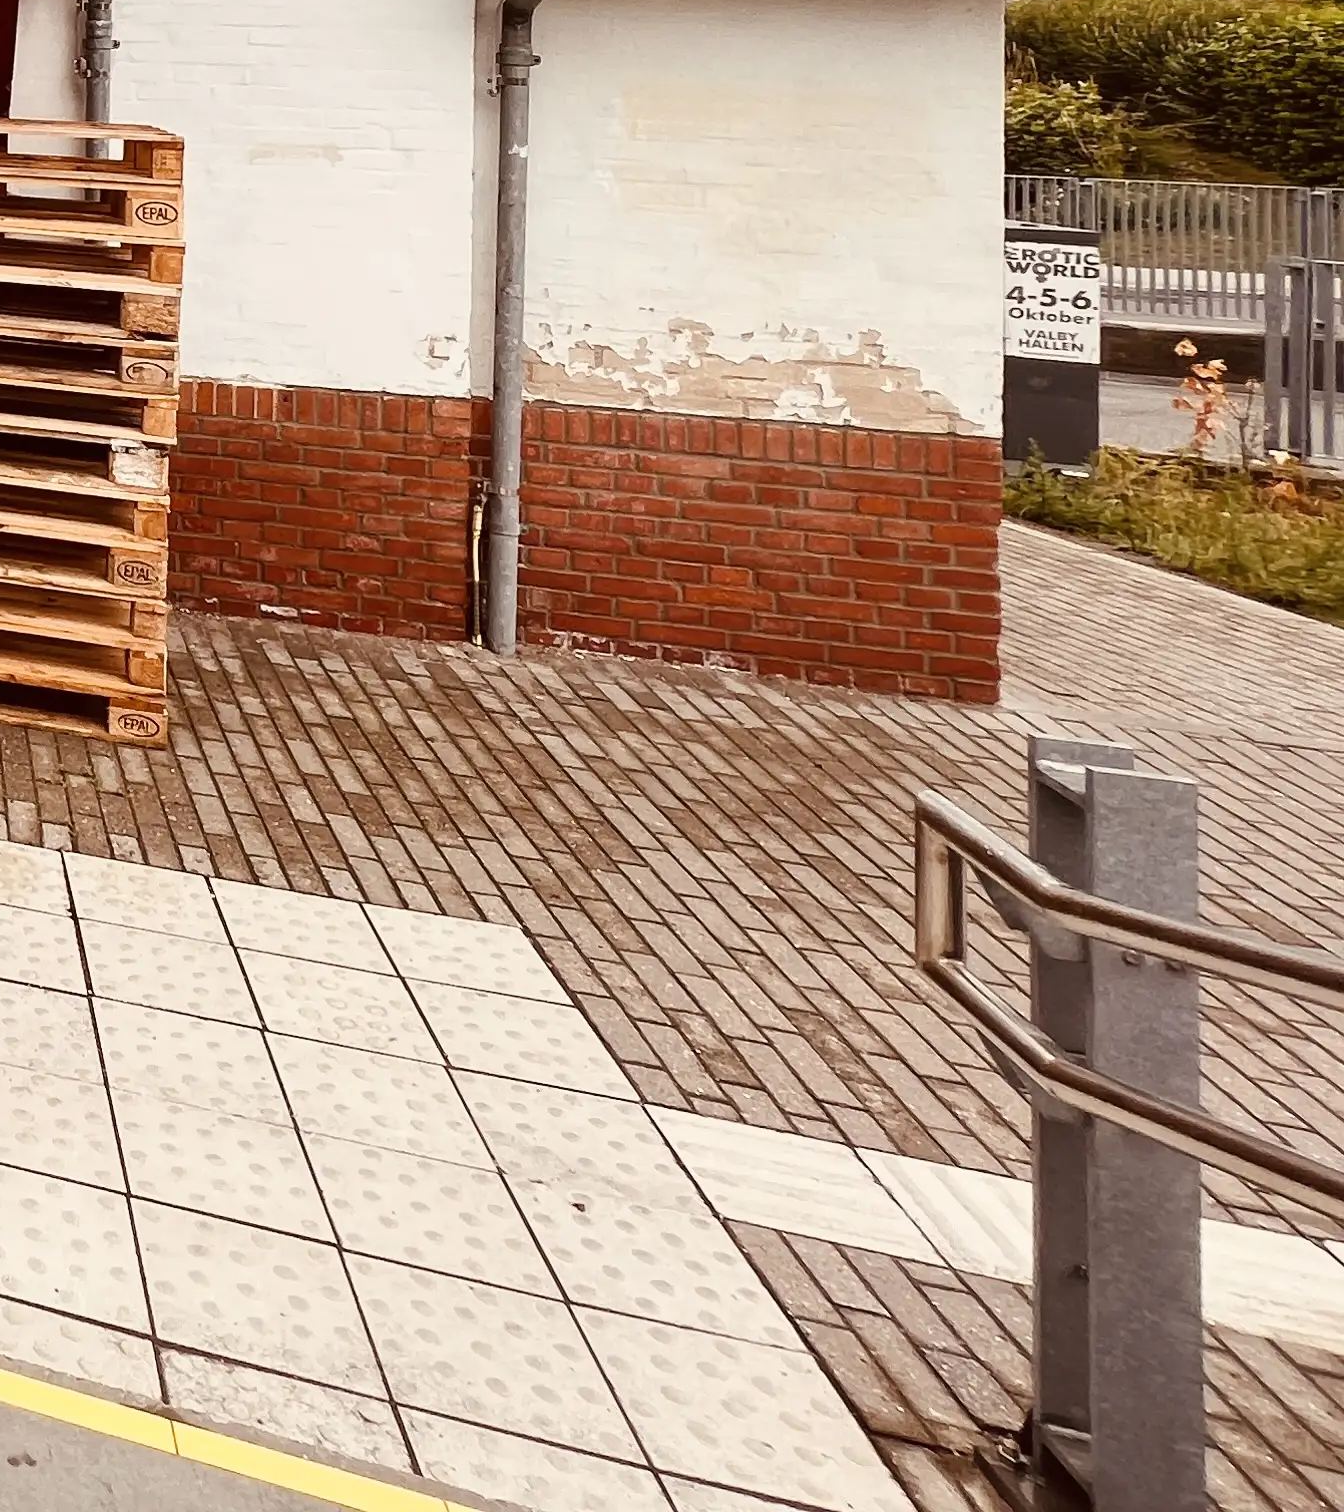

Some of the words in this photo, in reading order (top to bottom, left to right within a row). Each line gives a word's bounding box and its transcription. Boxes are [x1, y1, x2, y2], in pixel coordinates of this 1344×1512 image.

[142, 206, 173, 221] EPAL
[1004, 247, 1100, 266] EROTIC
[1006, 261, 1100, 281] WORLD
[1005, 286, 1099, 311] 4-5-6.
[1008, 307, 1096, 325] Oktober
[1023, 329, 1080, 341] VALBY
[1018, 338, 1084, 353] HALLEN
[123, 717, 153, 734] EPAL
